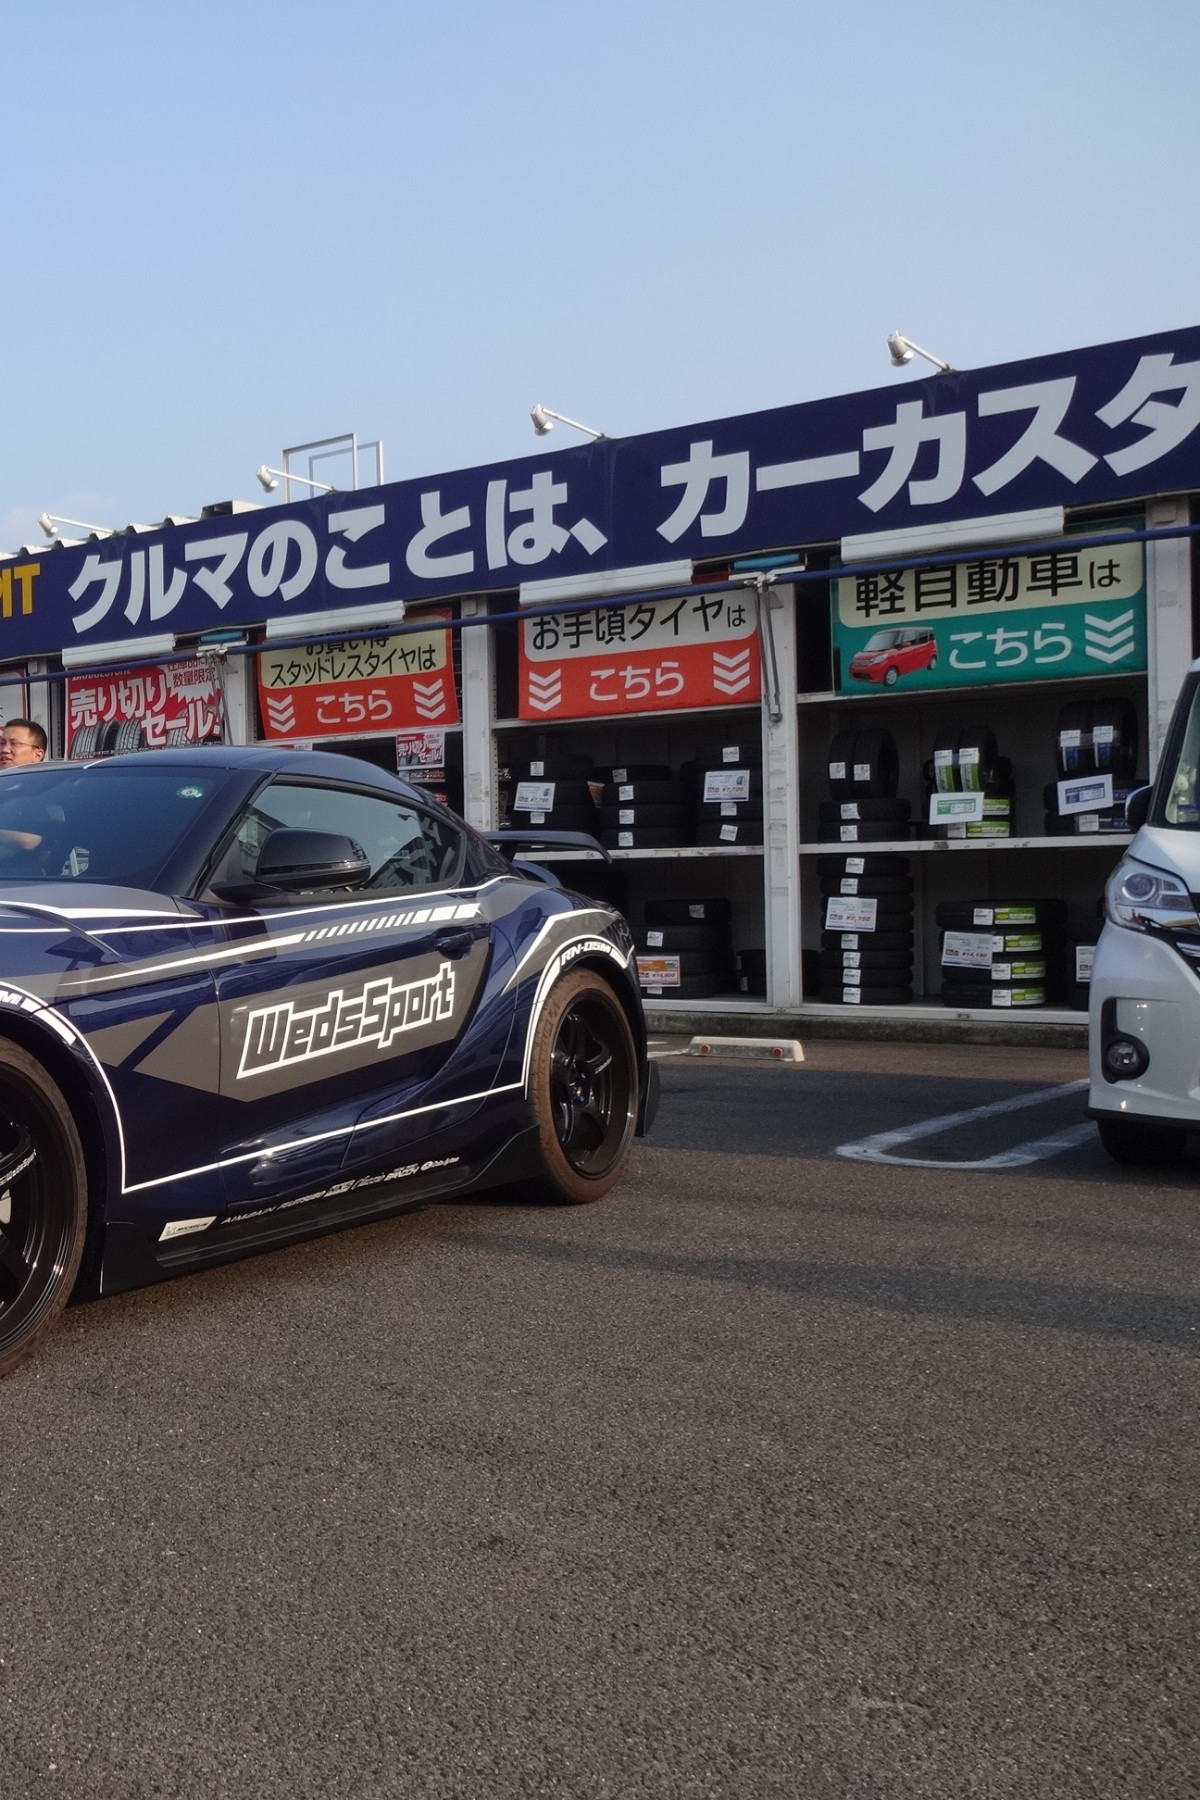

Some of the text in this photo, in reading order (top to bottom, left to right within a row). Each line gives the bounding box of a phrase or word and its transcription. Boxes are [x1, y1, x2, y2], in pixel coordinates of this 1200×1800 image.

[856, 550, 1121, 618] 軽自動車は
[532, 596, 746, 650] お手頃タイヤは
[950, 623, 1072, 668] こちら
[271, 644, 436, 687] スタッドレスタイヤは
[590, 662, 684, 700] こちら
[70, 674, 167, 730] 売り切り
[315, 690, 393, 723] こちら
[235, 962, 456, 1079] WedsSport
